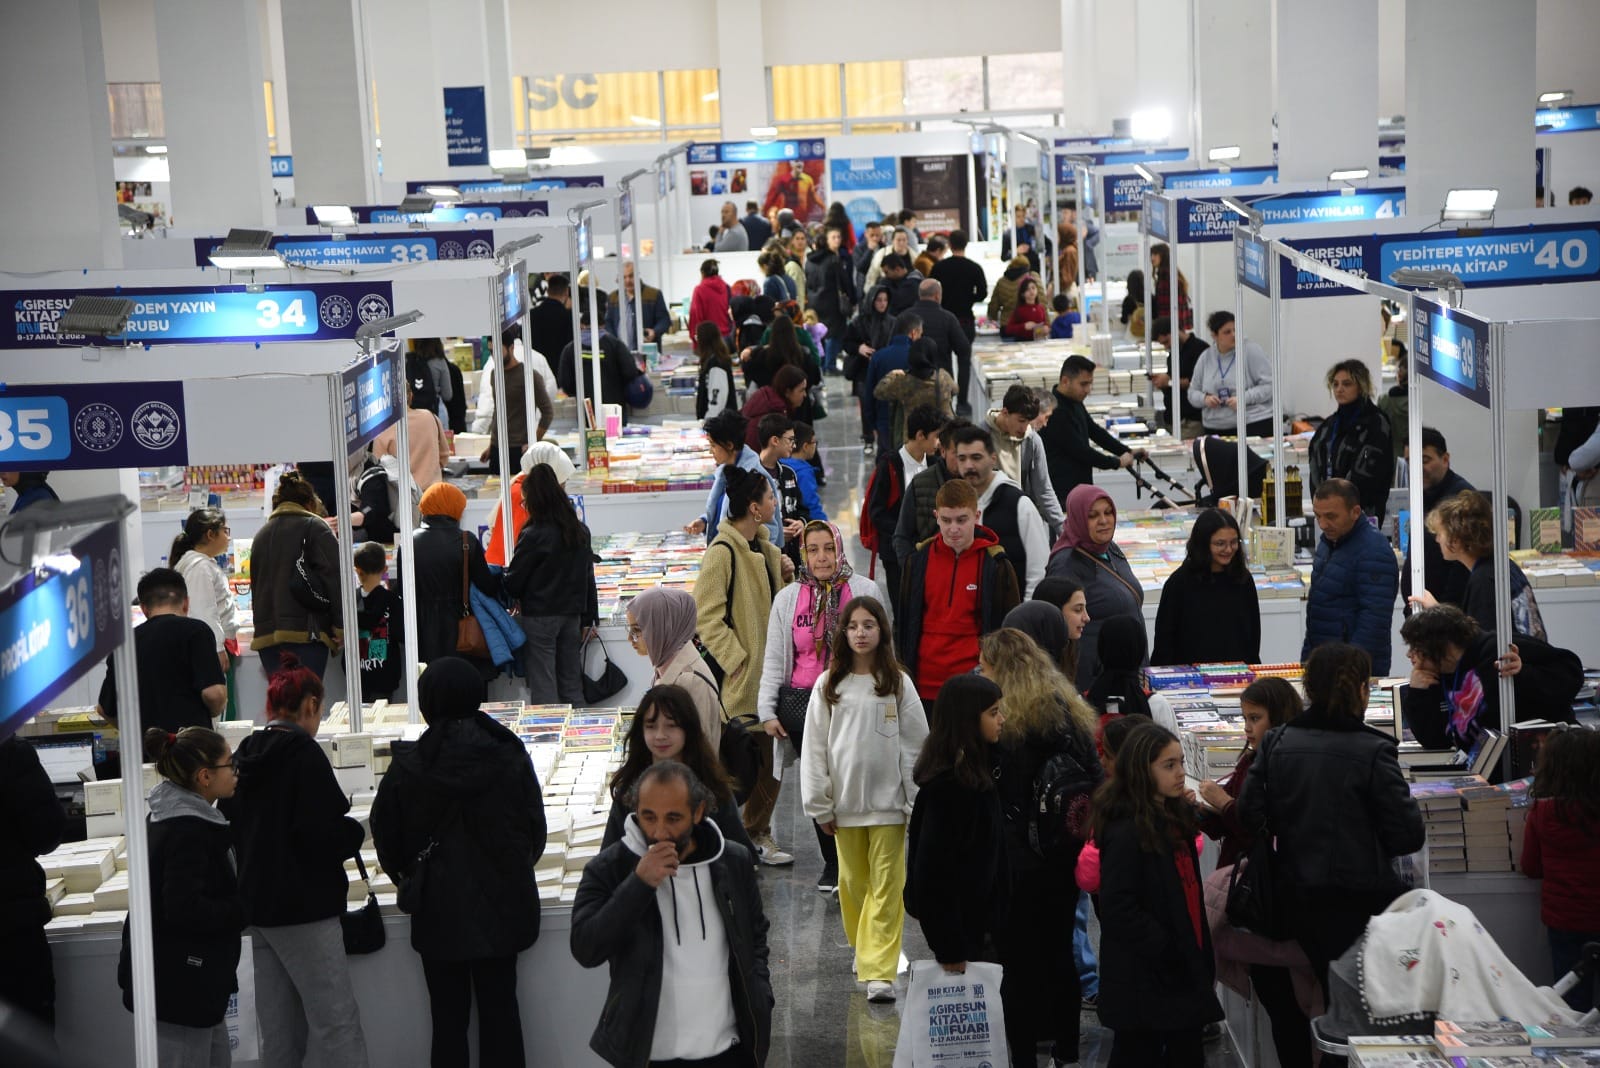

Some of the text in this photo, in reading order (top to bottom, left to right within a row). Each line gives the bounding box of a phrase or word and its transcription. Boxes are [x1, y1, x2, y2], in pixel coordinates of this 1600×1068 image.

[1189, 212, 1222, 223] KİTAP
[1303, 205, 1364, 218] YAYINLARI
[323, 247, 351, 258] GENÇ
[353, 246, 385, 255] HAYAT
[1393, 239, 1588, 269] YEDİTEPE YAYINEVİ 40
[1465, 259, 1508, 273] KİTAP
[15, 310, 61, 322] KİTAP
[170, 301, 216, 314] YAYIN
[255, 299, 306, 328] 34
[127, 320, 170, 332] RUBU
[1461, 336, 1474, 379] 39
[66, 575, 90, 649] 36
[360, 658, 385, 671] ARTY
[942, 985, 966, 994] KİTAP
[929, 1014, 968, 1026] KİTAP
[949, 1022, 989, 1035] FUARI
